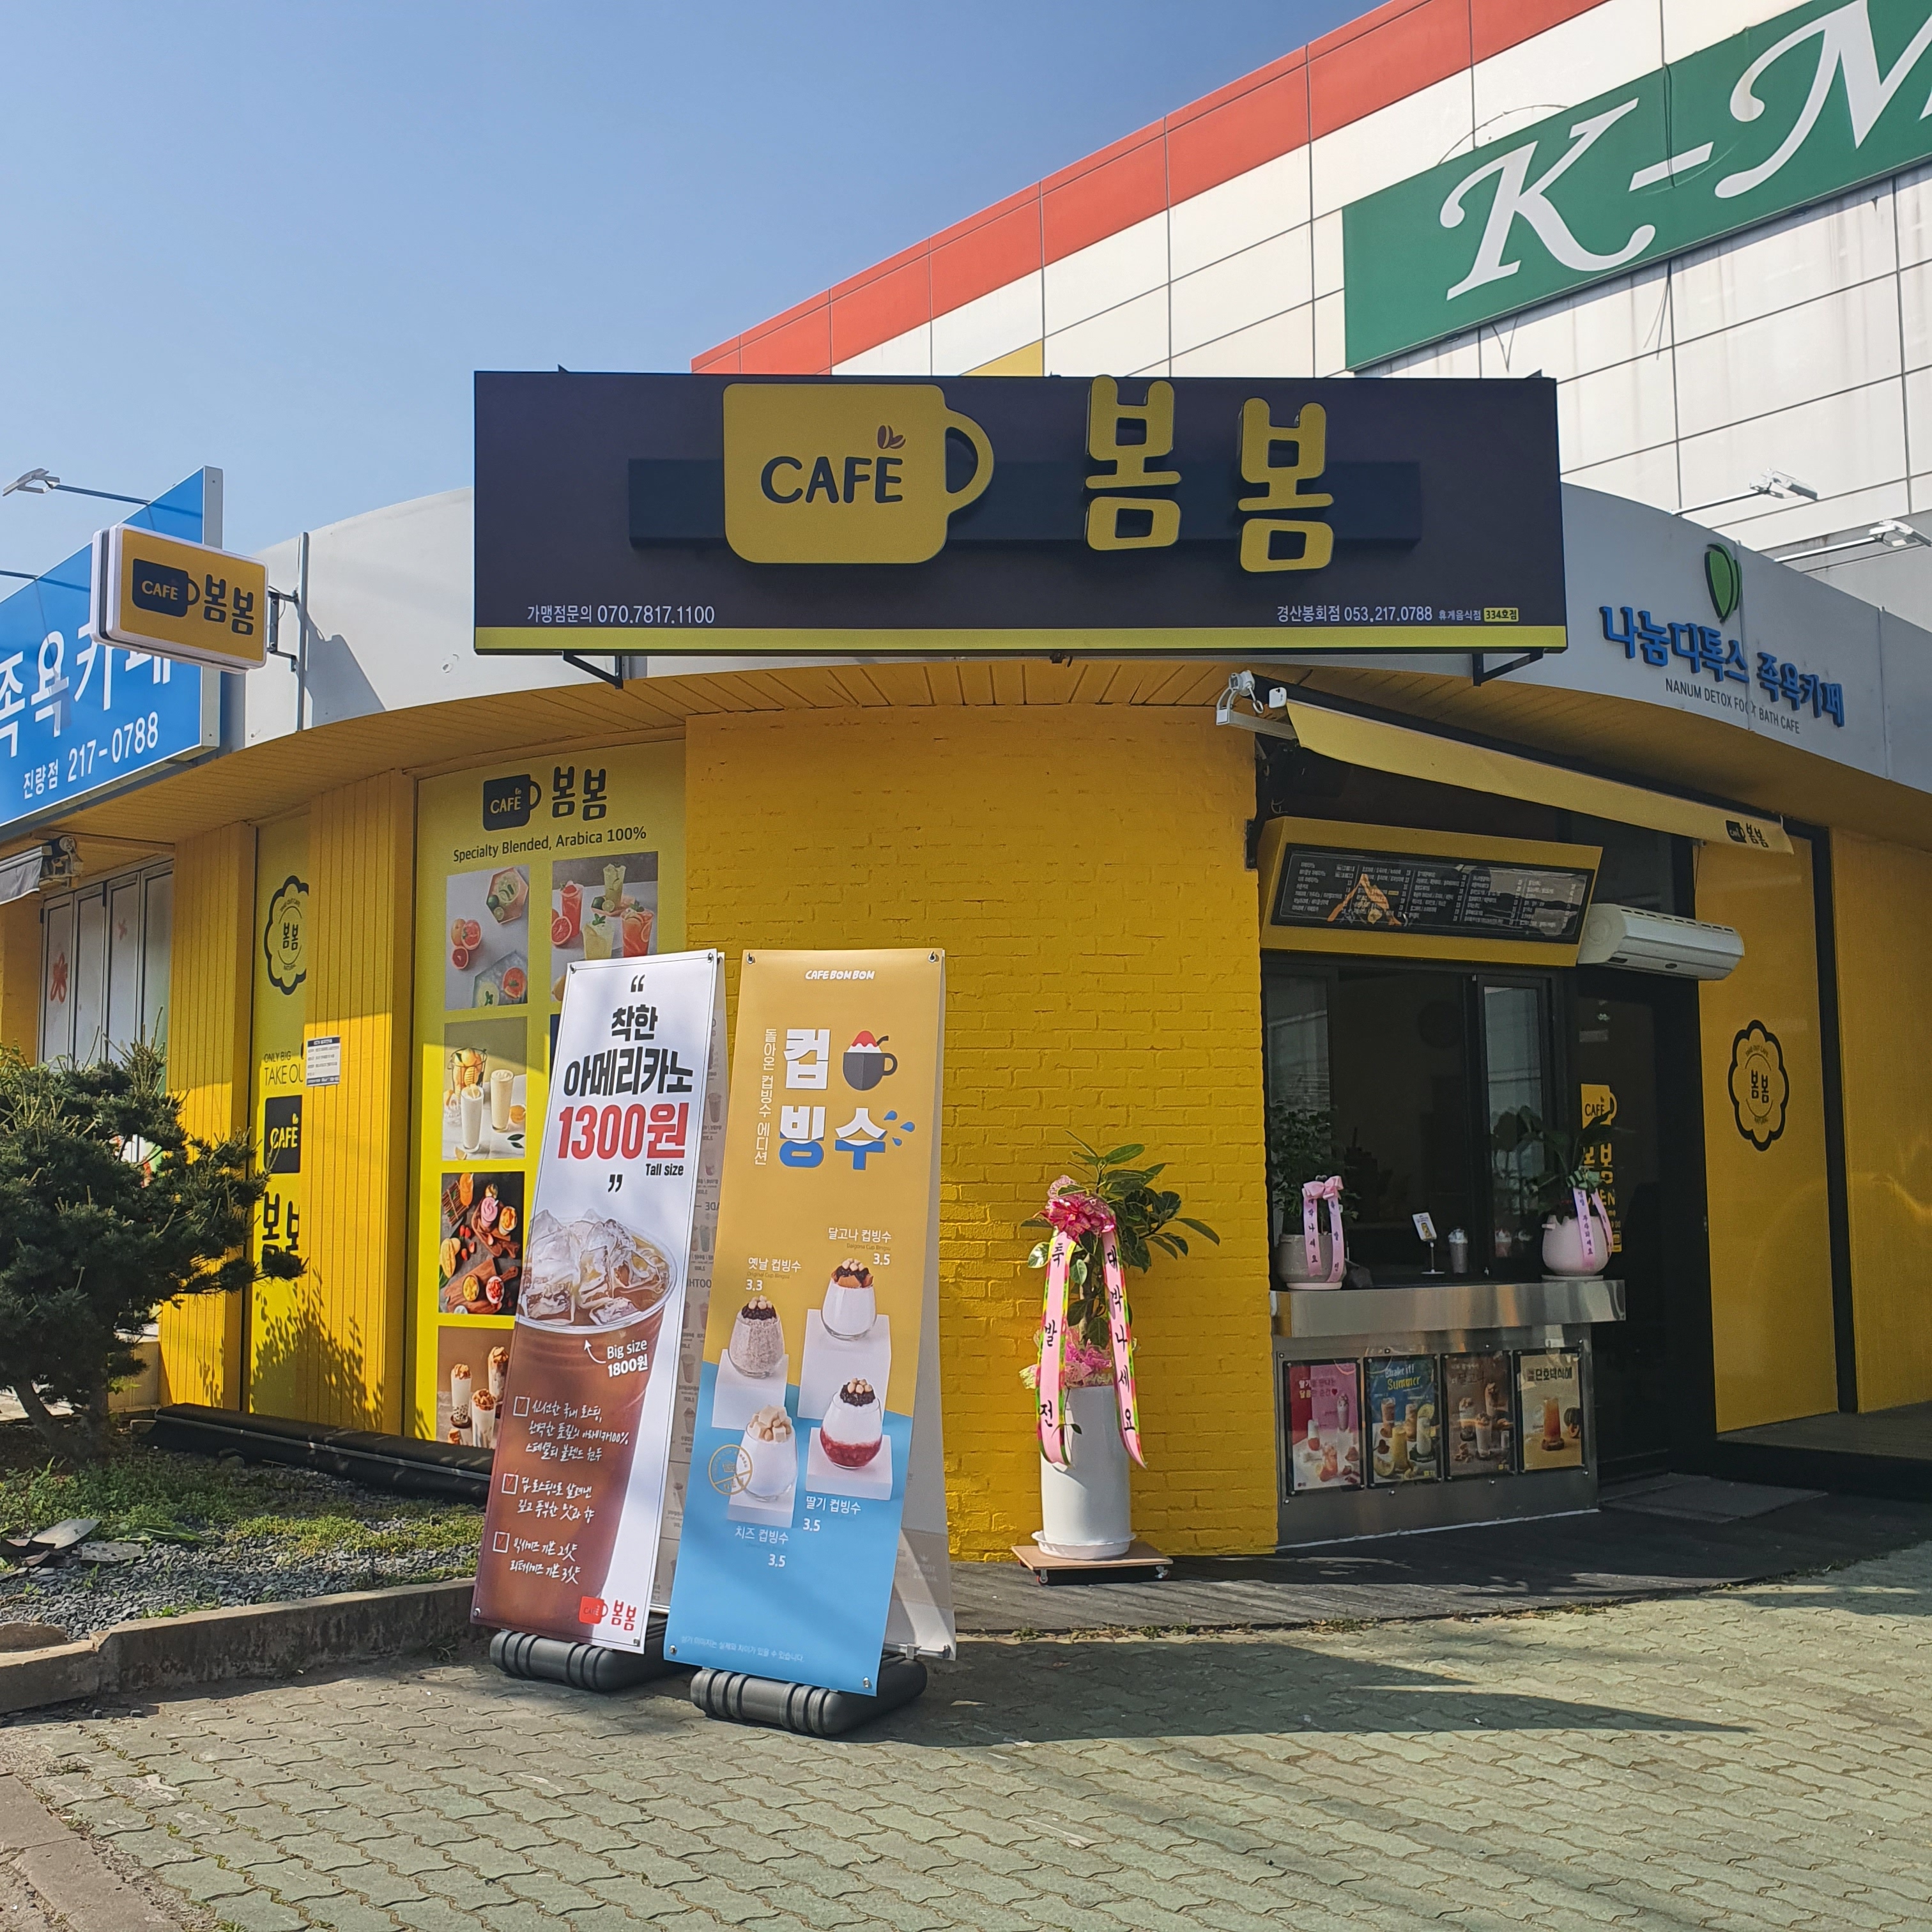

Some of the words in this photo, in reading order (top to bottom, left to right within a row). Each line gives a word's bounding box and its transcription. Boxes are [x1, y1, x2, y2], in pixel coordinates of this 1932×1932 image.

[760, 456, 903, 504] CAFE
[1084, 374, 1334, 573] 봄봄
[141, 580, 179, 601] CAFE
[203, 574, 254, 636] 봄봄
[527, 604, 592, 624] 가맹점문의
[597, 605, 715, 624] 070.7817.1100
[1277, 604, 1340, 623] 경산봉회점
[1344, 606, 1432, 622] 053.217.0788
[1438, 610, 1482, 622] 휴게음식점
[1485, 610, 1517, 620] 334호점
[1599, 606, 1750, 683] 나눔디톡스
[1757, 652, 1844, 728] 족욕카페
[1666, 678, 1701, 700] NANUM
[1705, 688, 1732, 708] DETOX
[1759, 707, 1779, 726] BATH
[1781, 716, 1800, 735] CAFE
[23, 758, 59, 800] 진량점
[68, 711, 158, 783] 217-0788
[490, 795, 522, 815] CAFE
[551, 766, 608, 822] 봄봄
[453, 843, 499, 863] Specialty
[502, 835, 552, 854] Blended,
[556, 831, 602, 847] Arabica
[607, 826, 647, 842] 100%
[805, 970, 829, 979] CAFE
[611, 1004, 658, 1041] 착한
[264, 1052, 280, 1063] ONLY
[763, 1028, 777, 1071] 돌아온
[783, 1029, 831, 1090] 컵
[264, 1065, 288, 1086] TAKE
[289, 1063, 303, 1083] OU
[564, 1046, 693, 1096] 아메리카노
[758, 1075, 774, 1118] 컵빙수
[1584, 1103, 1605, 1116] CAFE
[270, 1126, 298, 1149] CAFE
[558, 1102, 689, 1160] 1300원
[755, 1121, 770, 1165] 에디션
[645, 1163, 663, 1176] Tall
[664, 1163, 684, 1176] size
[828, 1227, 859, 1241] 달고나
[861, 1229, 892, 1243] 컵빙수
[748, 1257, 769, 1271] 옛날
[771, 1259, 802, 1273] 컵빙수
[873, 1253, 891, 1265] 3.5
[746, 1279, 763, 1291] 3.3
[607, 1344, 624, 1360] Big
[627, 1339, 647, 1354] size
[608, 1353, 648, 1377] 1800원
[1387, 1376, 1421, 1391] Summer
[532, 1399, 561, 1416] 신선한
[564, 1402, 578, 1419] 국내
[580, 1405, 602, 1423] 로스팅,
[528, 1420, 556, 1438] 완벽한
[556, 1422, 580, 1440] 품질의
[525, 1441, 559, 1460] 스페셜티
[586, 1446, 602, 1462] 원두
[521, 1476, 532, 1493] 딥
[532, 1479, 564, 1496] 로스팅으로
[518, 1499, 533, 1514] 깊고
[560, 1503, 581, 1521] 맛과
[584, 1505, 595, 1524] 향
[806, 1496, 826, 1511] 딸기
[830, 1498, 861, 1515] 컵빙수
[735, 1526, 755, 1539] 치즈
[758, 1529, 789, 1545] 컵빙수
[802, 1518, 821, 1531] 3.5
[514, 1537, 540, 1554] 빅사이즈
[541, 1540, 556, 1555] 기본
[557, 1543, 578, 1562] 2샷
[768, 1554, 786, 1567] 3.5
[510, 1560, 544, 1574] 리터사이즈
[546, 1563, 560, 1578] 기본
[560, 1565, 581, 1584] 3샷
[611, 1599, 637, 1631] 봄봄
[737, 1644, 756, 1654] 차이가
[757, 1648, 769, 1657] 있을
